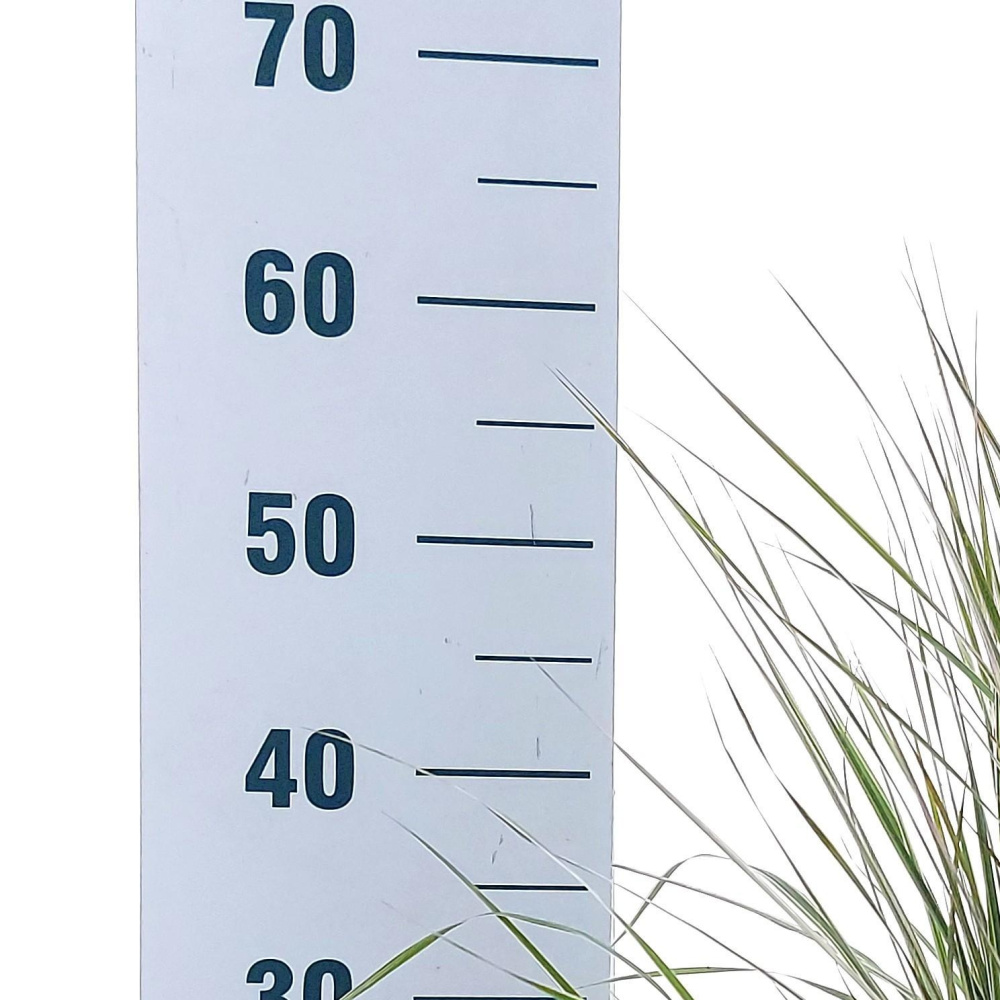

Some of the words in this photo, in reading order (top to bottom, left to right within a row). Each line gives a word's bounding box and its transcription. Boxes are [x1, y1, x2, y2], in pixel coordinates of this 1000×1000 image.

[245, 2, 354, 91] 70
[245, 249, 354, 337] 60
[247, 492, 354, 576] 50
[246, 729, 354, 810] 40
